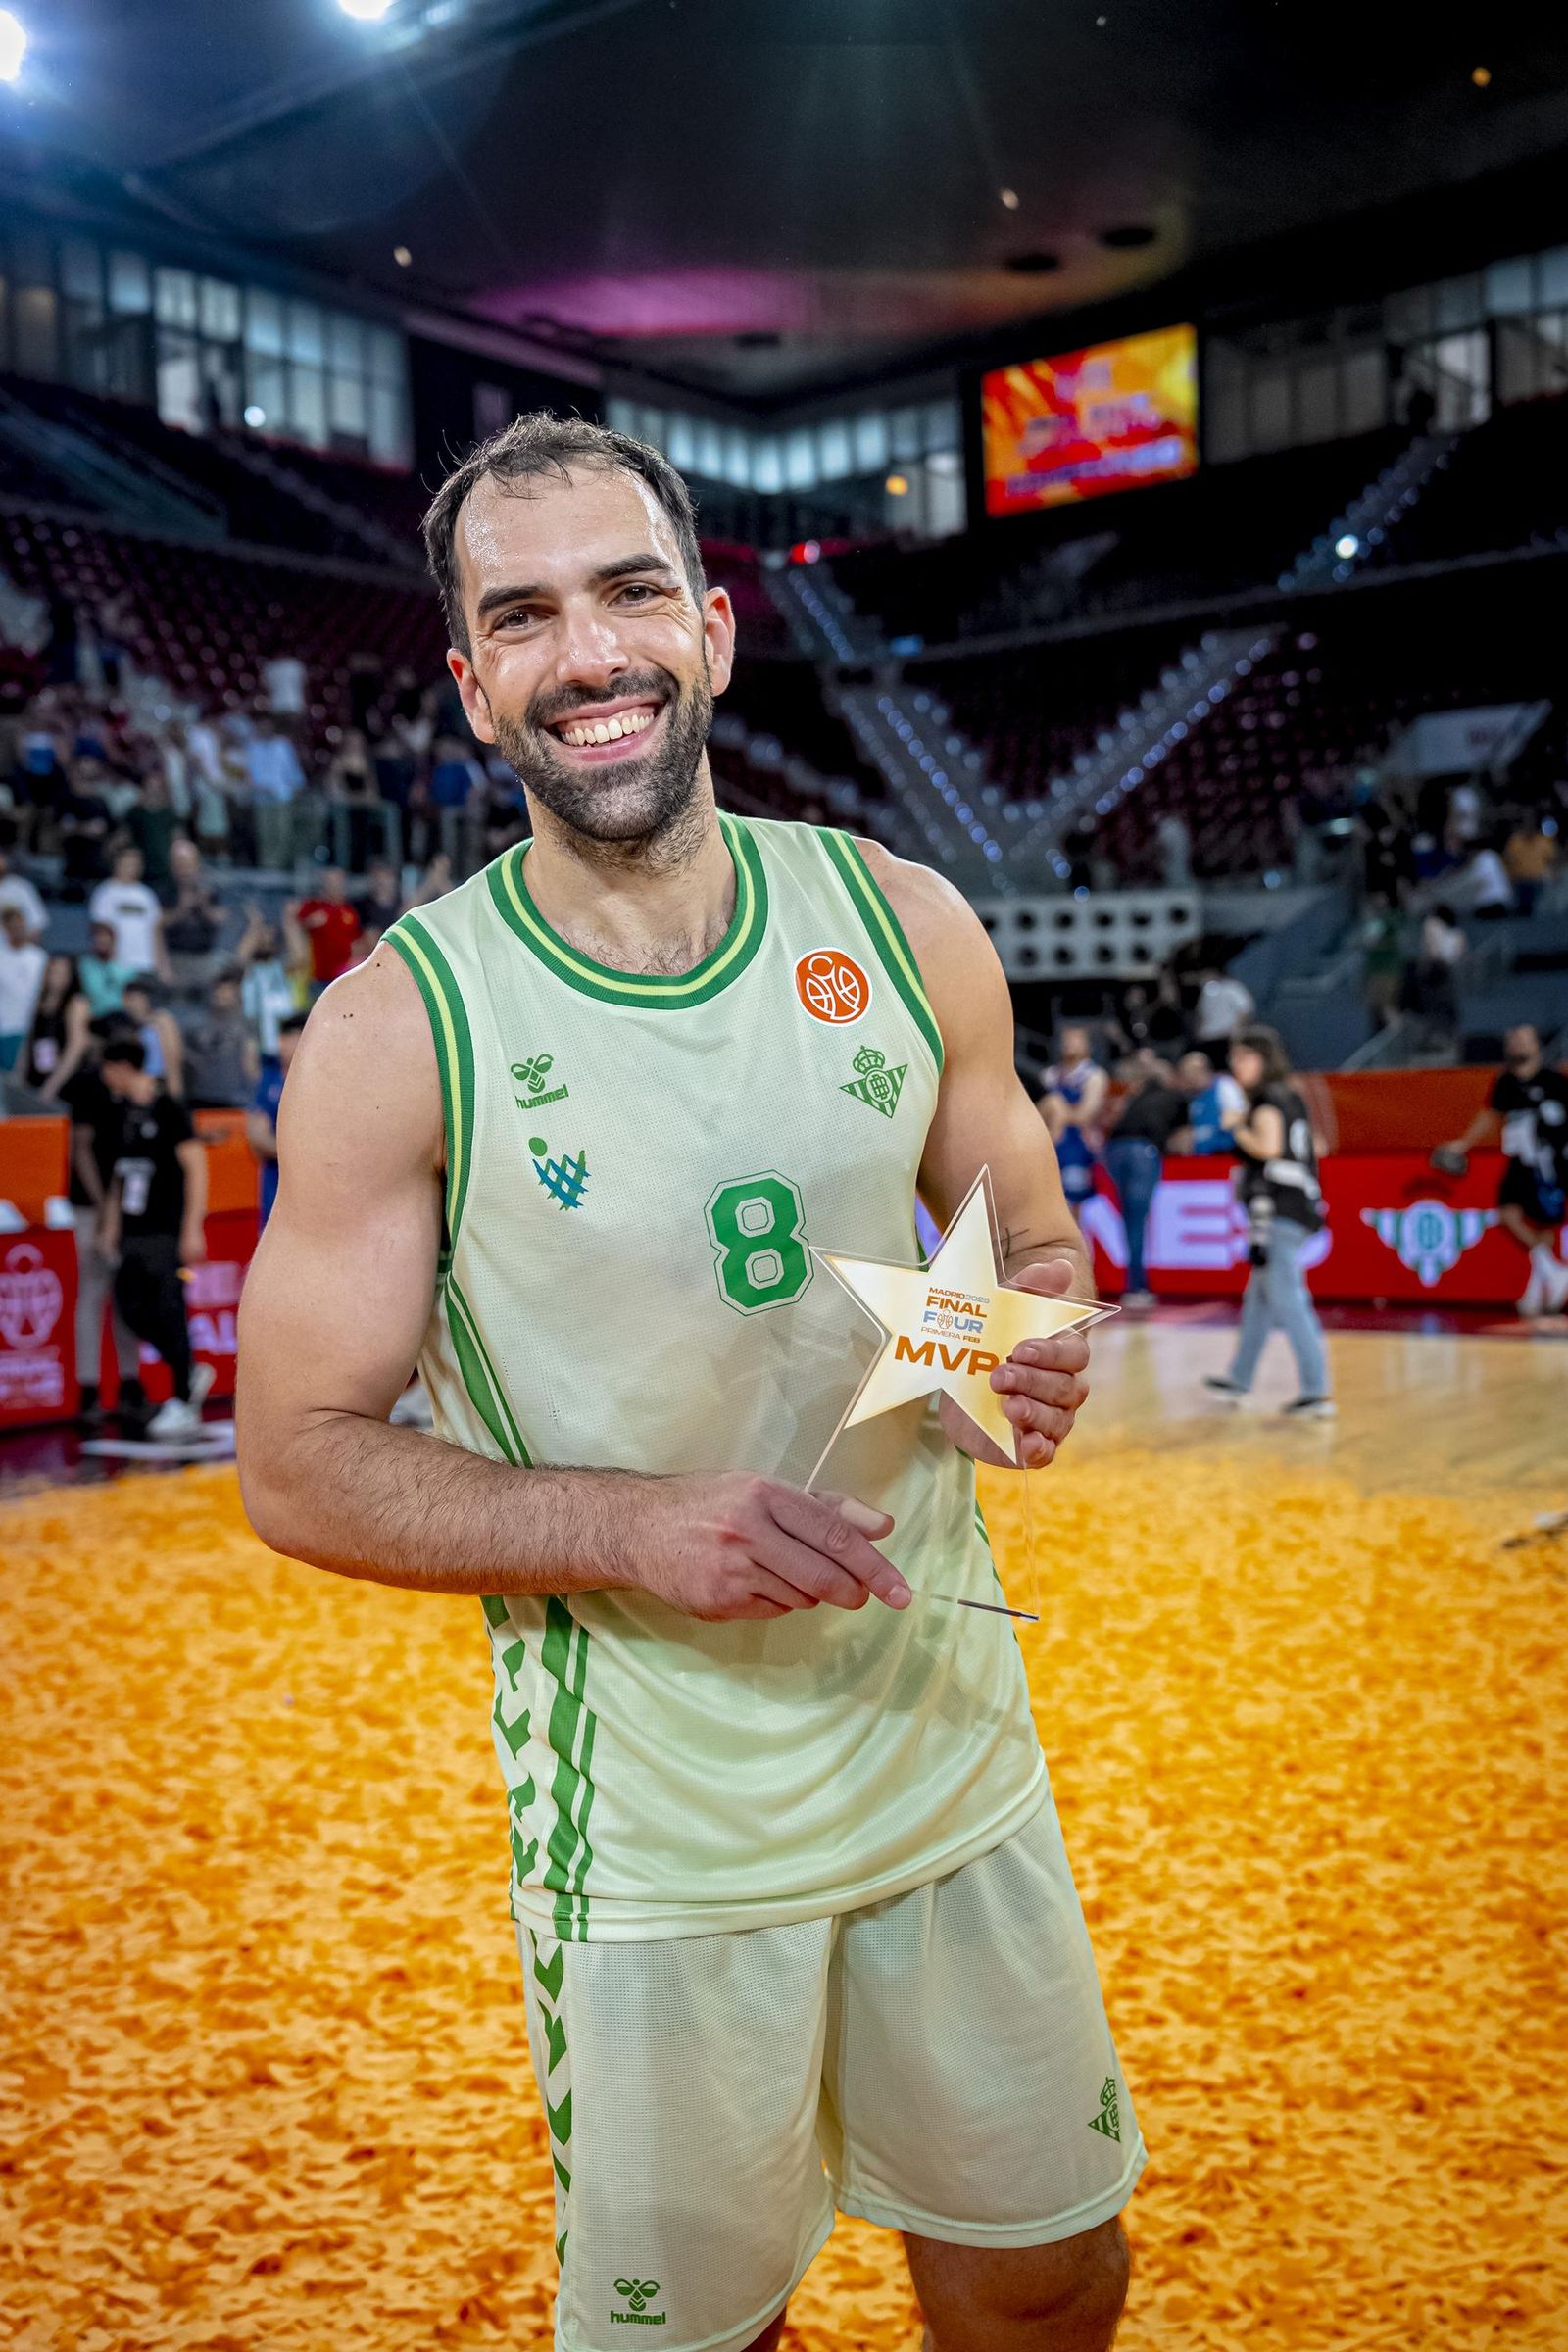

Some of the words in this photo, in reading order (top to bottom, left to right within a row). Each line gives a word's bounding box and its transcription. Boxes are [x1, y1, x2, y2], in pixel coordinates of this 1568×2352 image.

[514, 1083, 569, 1109] hummel
[704, 1169, 814, 1316] 8
[926, 1295, 988, 1318] FINAL
[921, 1326, 961, 1340] PRIMERA
[962, 1335, 981, 1344] FEB
[894, 1335, 1000, 1376] MVP
[610, 2310, 666, 2326] hummel
